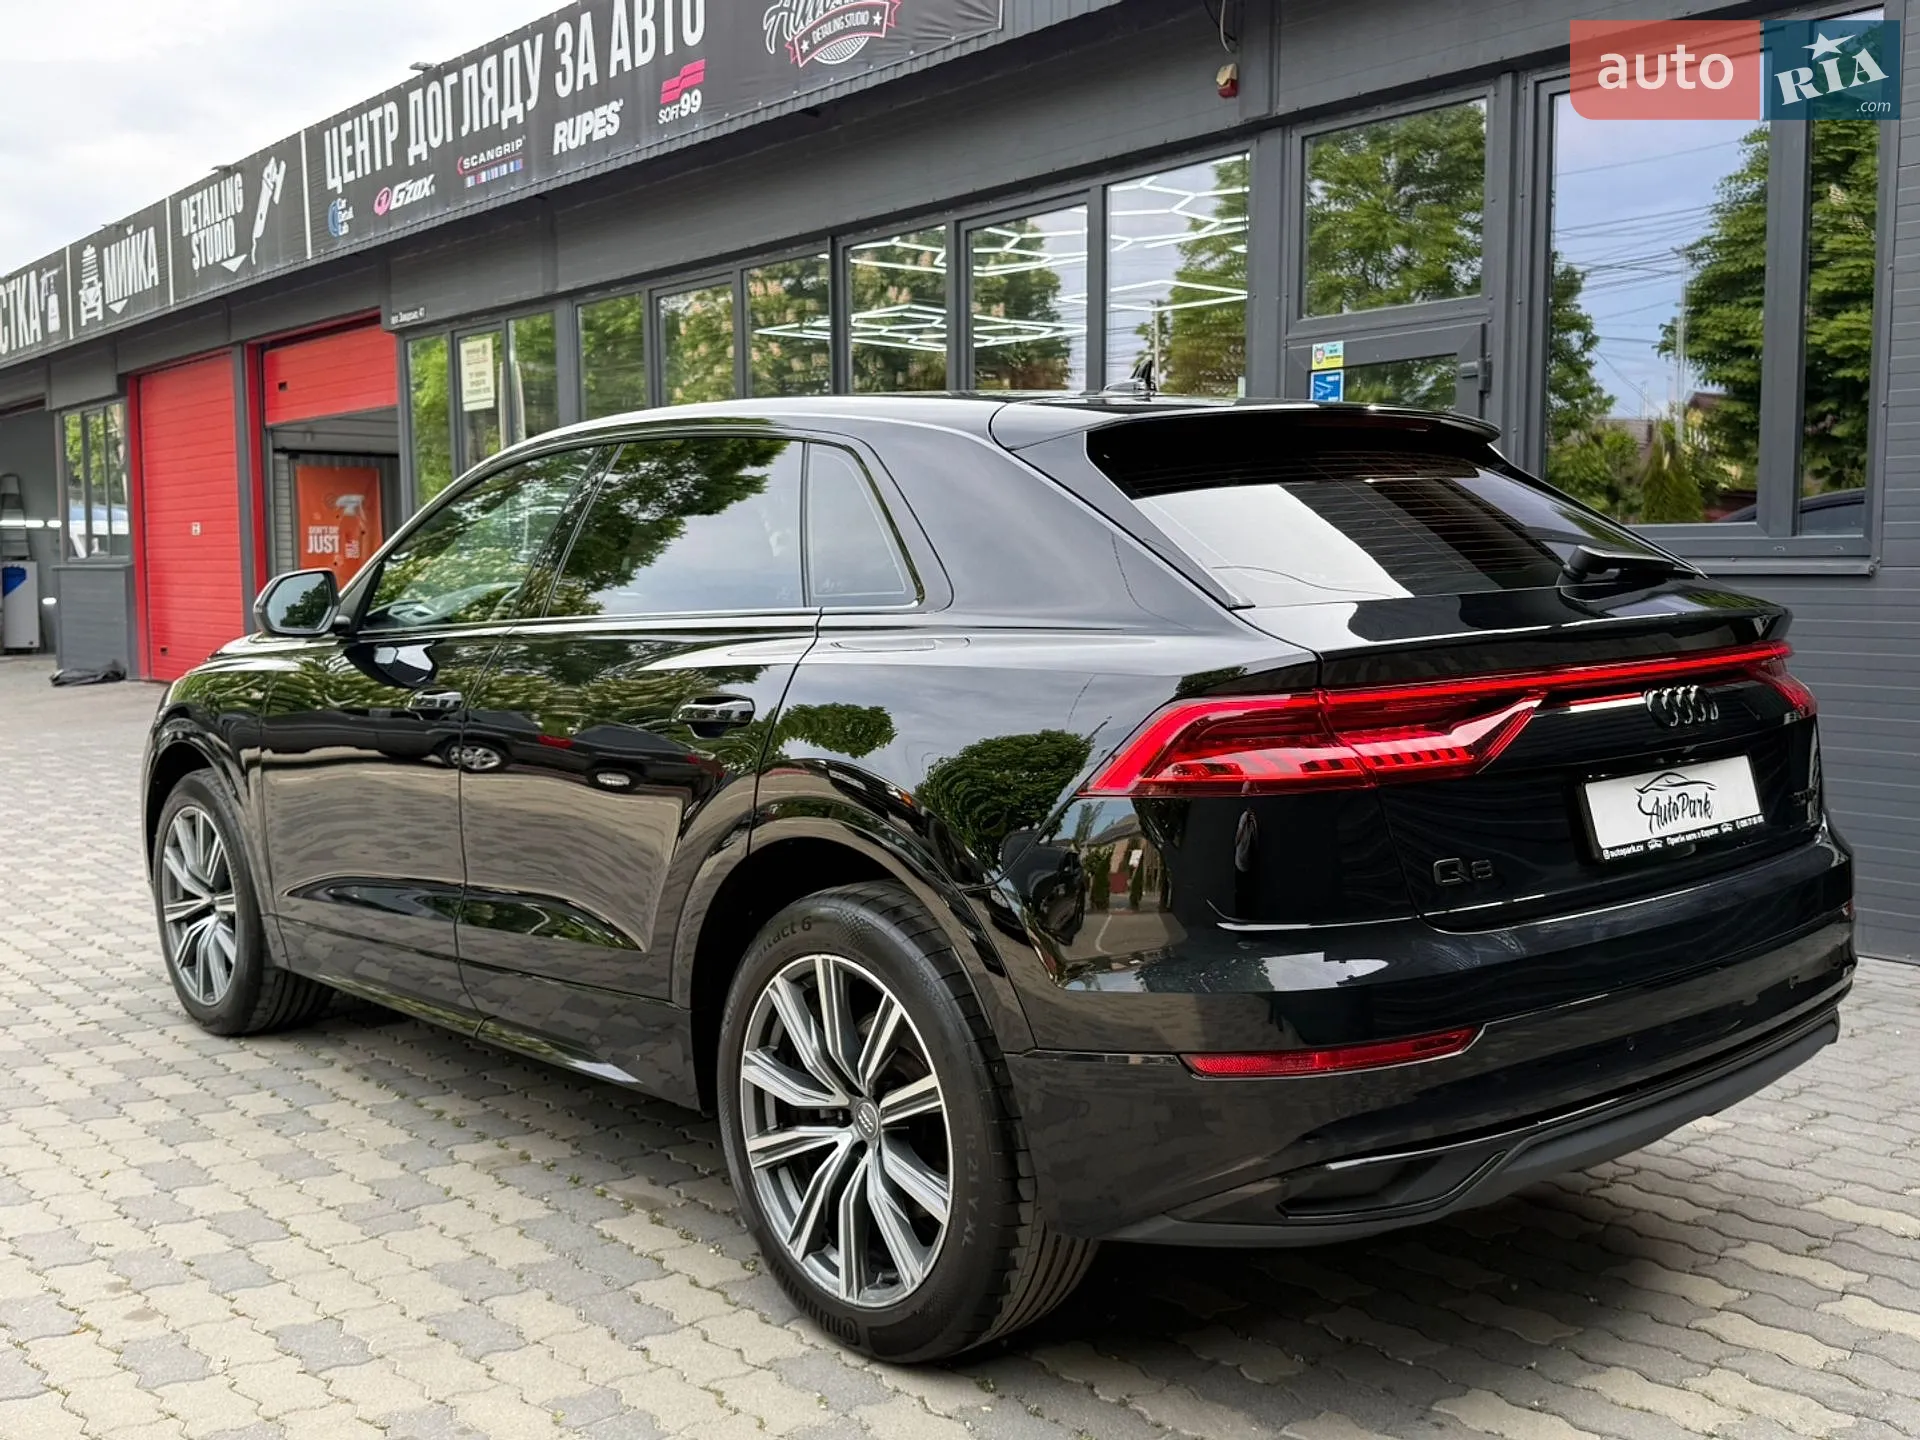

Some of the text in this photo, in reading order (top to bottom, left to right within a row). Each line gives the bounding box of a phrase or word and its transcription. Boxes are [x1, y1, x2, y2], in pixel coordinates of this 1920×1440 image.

[324, 101, 399, 194] ЦЕНТР
[407, 32, 544, 167] ДОГЛЯДУ
[554, 11, 598, 98] ЗА
[553, 99, 622, 155] RUPES
[462, 138, 524, 170] SCANGRIP
[180, 171, 244, 237] DETAILING
[103, 224, 160, 305] МИЙКА
[191, 217, 236, 271] STUDIO
[308, 535, 340, 554] JUST
[1433, 857, 1494, 886] Q8
